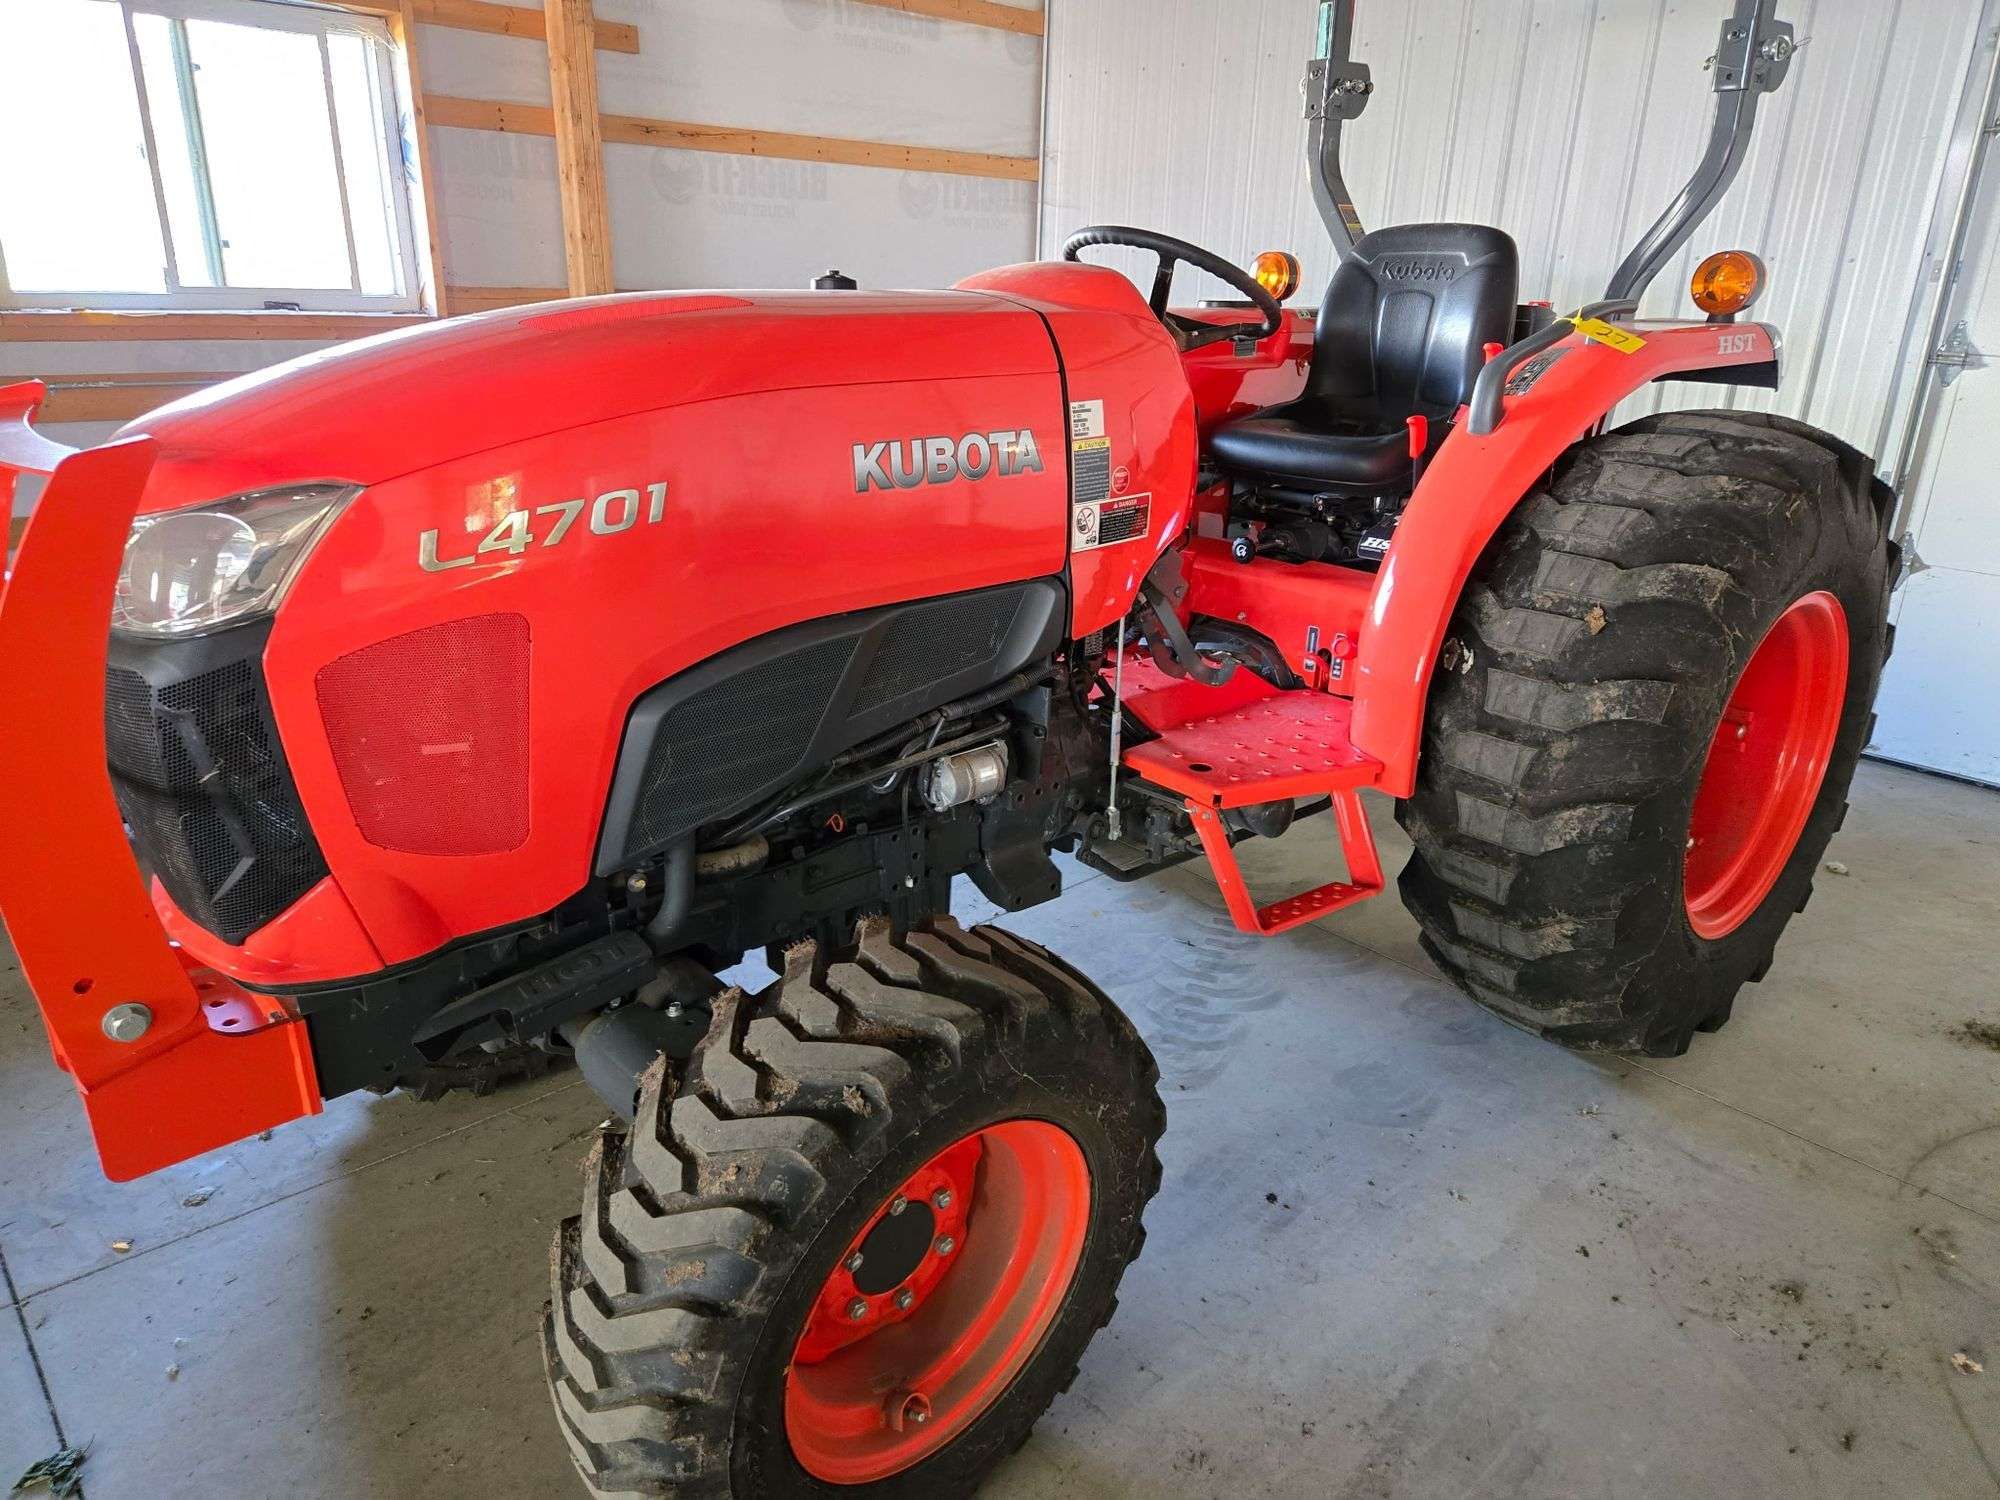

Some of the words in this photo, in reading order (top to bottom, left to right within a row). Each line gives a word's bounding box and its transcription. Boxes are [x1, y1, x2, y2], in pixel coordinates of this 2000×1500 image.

[1380, 261, 1456, 280] Kubota
[1717, 333, 1757, 355] HST
[852, 428, 1045, 493] KUBOTA
[418, 481, 669, 573] L4701
